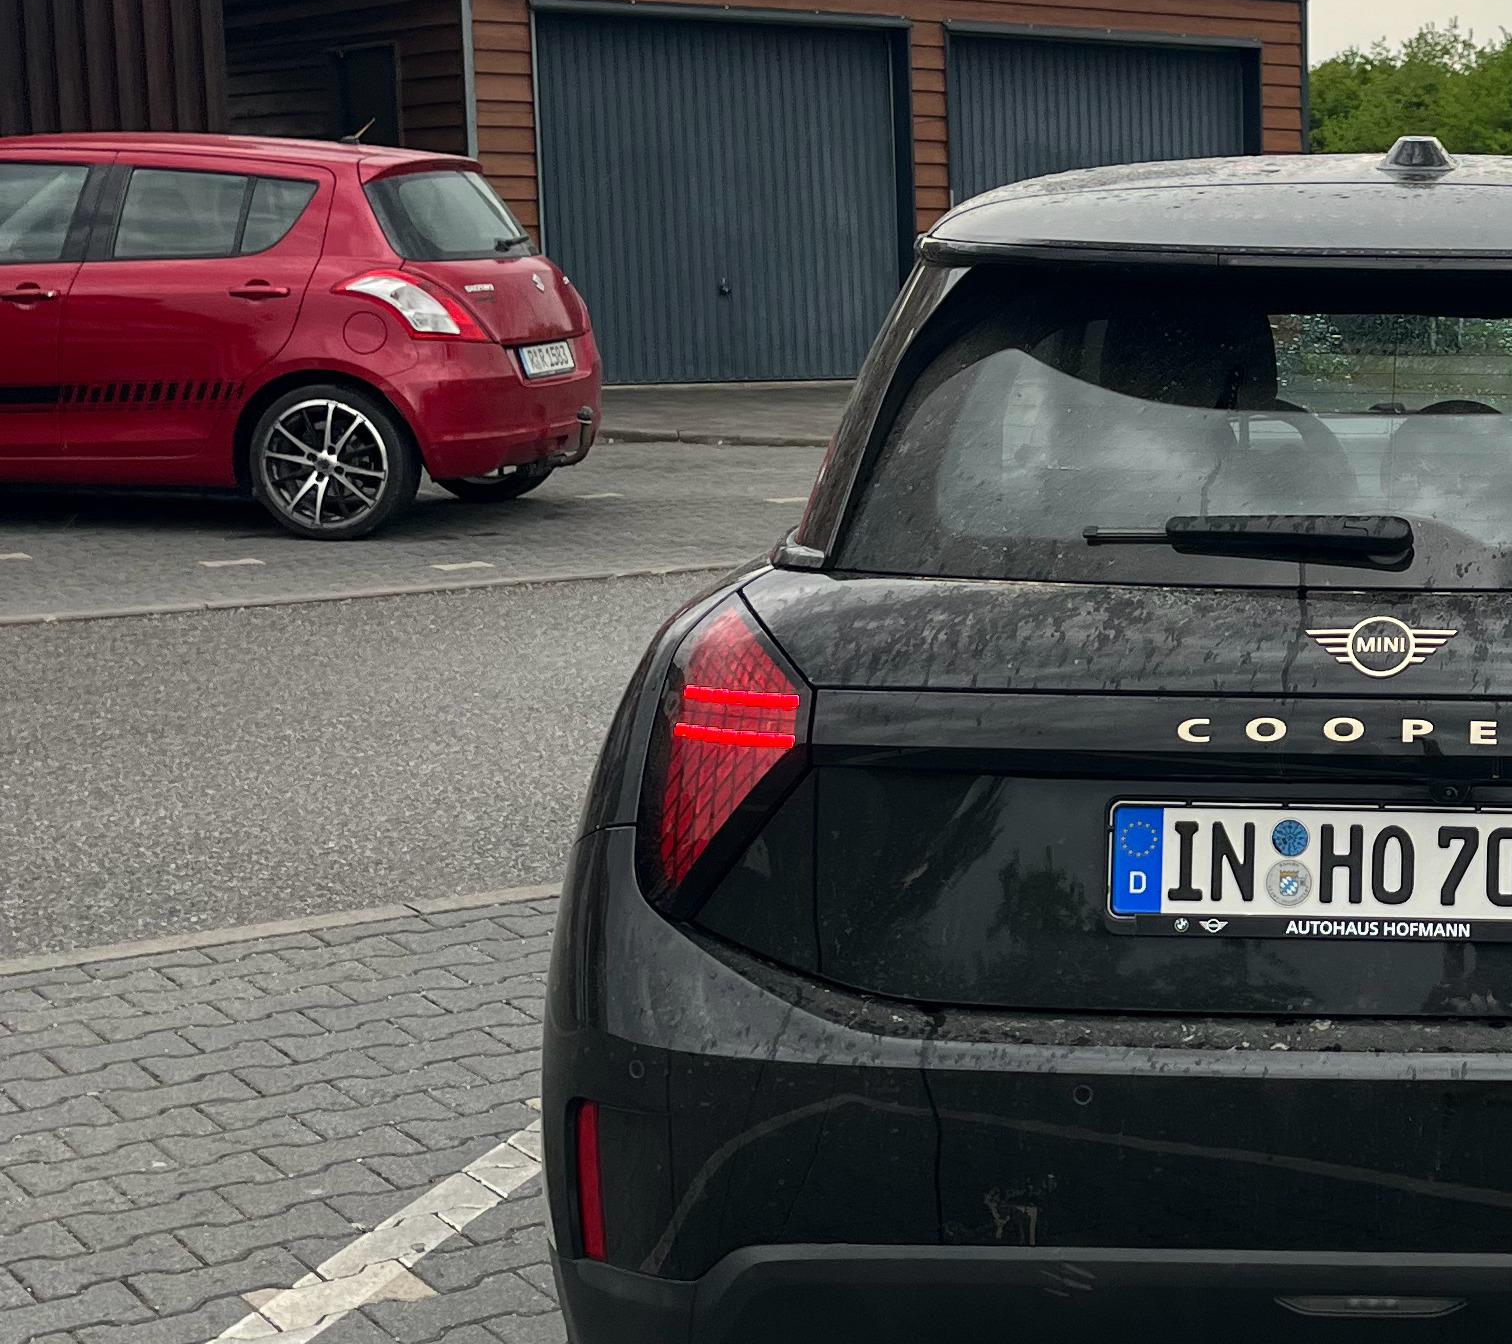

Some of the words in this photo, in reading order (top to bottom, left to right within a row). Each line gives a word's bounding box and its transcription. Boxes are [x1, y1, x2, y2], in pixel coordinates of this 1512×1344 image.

[1356, 636, 1406, 653] MINI
[1167, 820, 1256, 903] IN
[1319, 822, 1416, 906] HO
[1129, 871, 1147, 895] D
[1285, 919, 1379, 937] AUTOHAUS
[1383, 920, 1471, 939] HOFMANN
